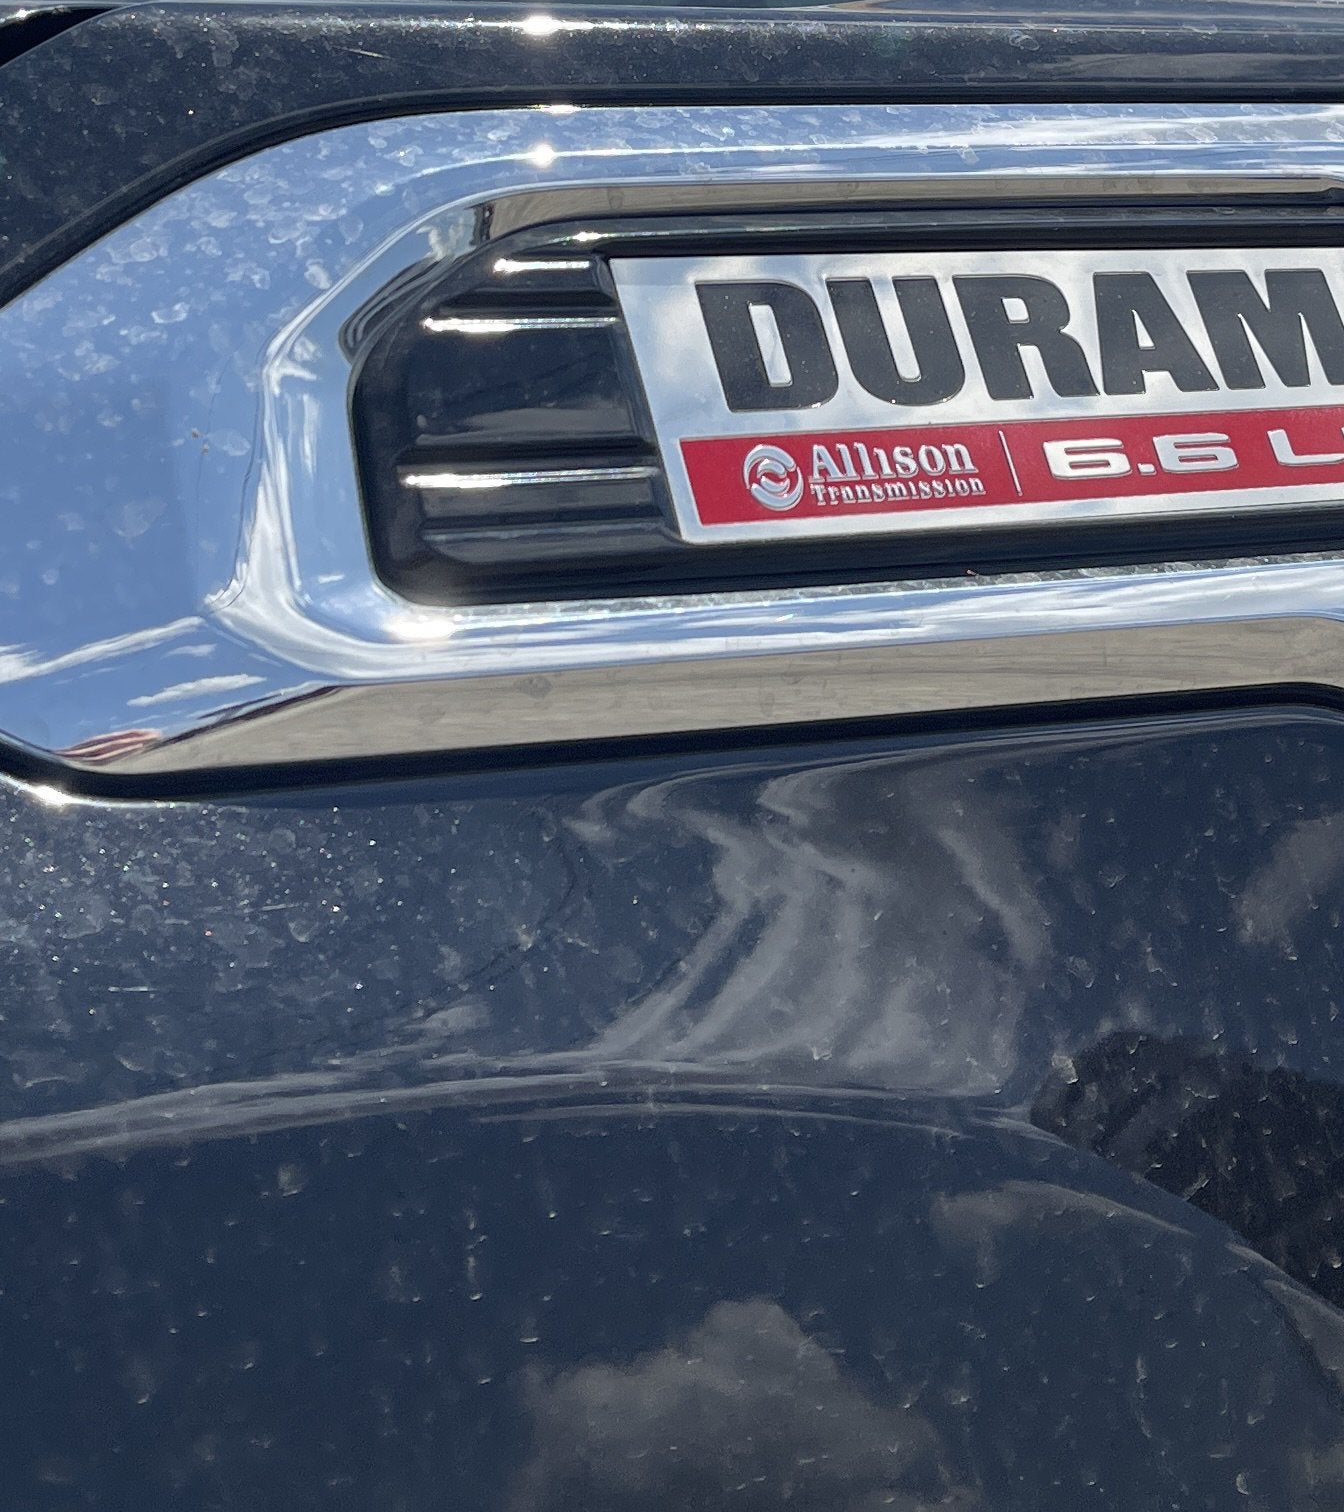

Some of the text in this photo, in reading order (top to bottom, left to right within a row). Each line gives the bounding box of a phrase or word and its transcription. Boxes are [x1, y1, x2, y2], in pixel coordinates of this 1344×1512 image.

[809, 441, 979, 483] Allison
[1042, 431, 1239, 480] 6.6
[810, 477, 987, 507] Transmission
